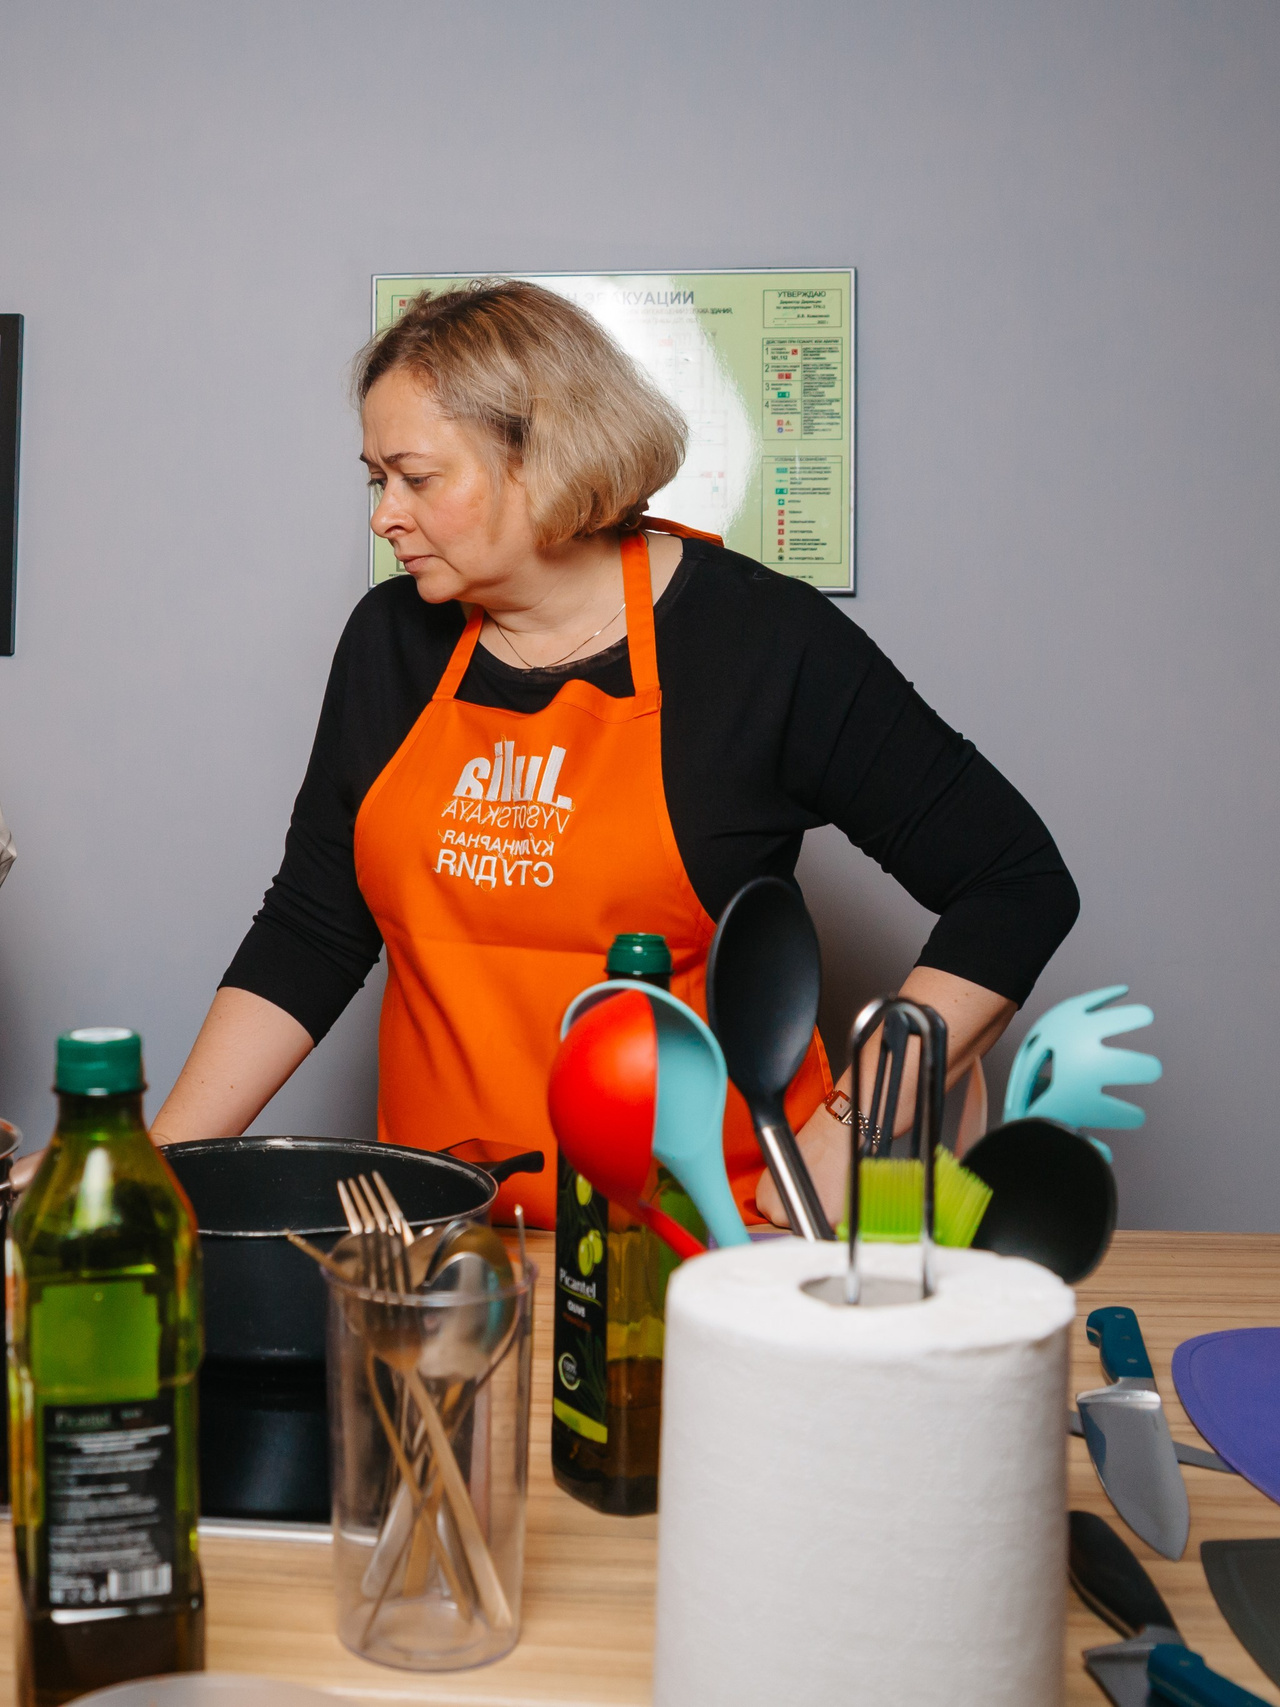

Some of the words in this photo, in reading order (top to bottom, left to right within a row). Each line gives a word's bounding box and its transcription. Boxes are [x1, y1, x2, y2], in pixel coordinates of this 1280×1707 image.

[765, 347, 769, 355] 1
[765, 364, 770, 372] 2
[765, 383, 770, 391] 3
[764, 401, 770, 409] 4
[559, 1267, 596, 1299] Picantel
